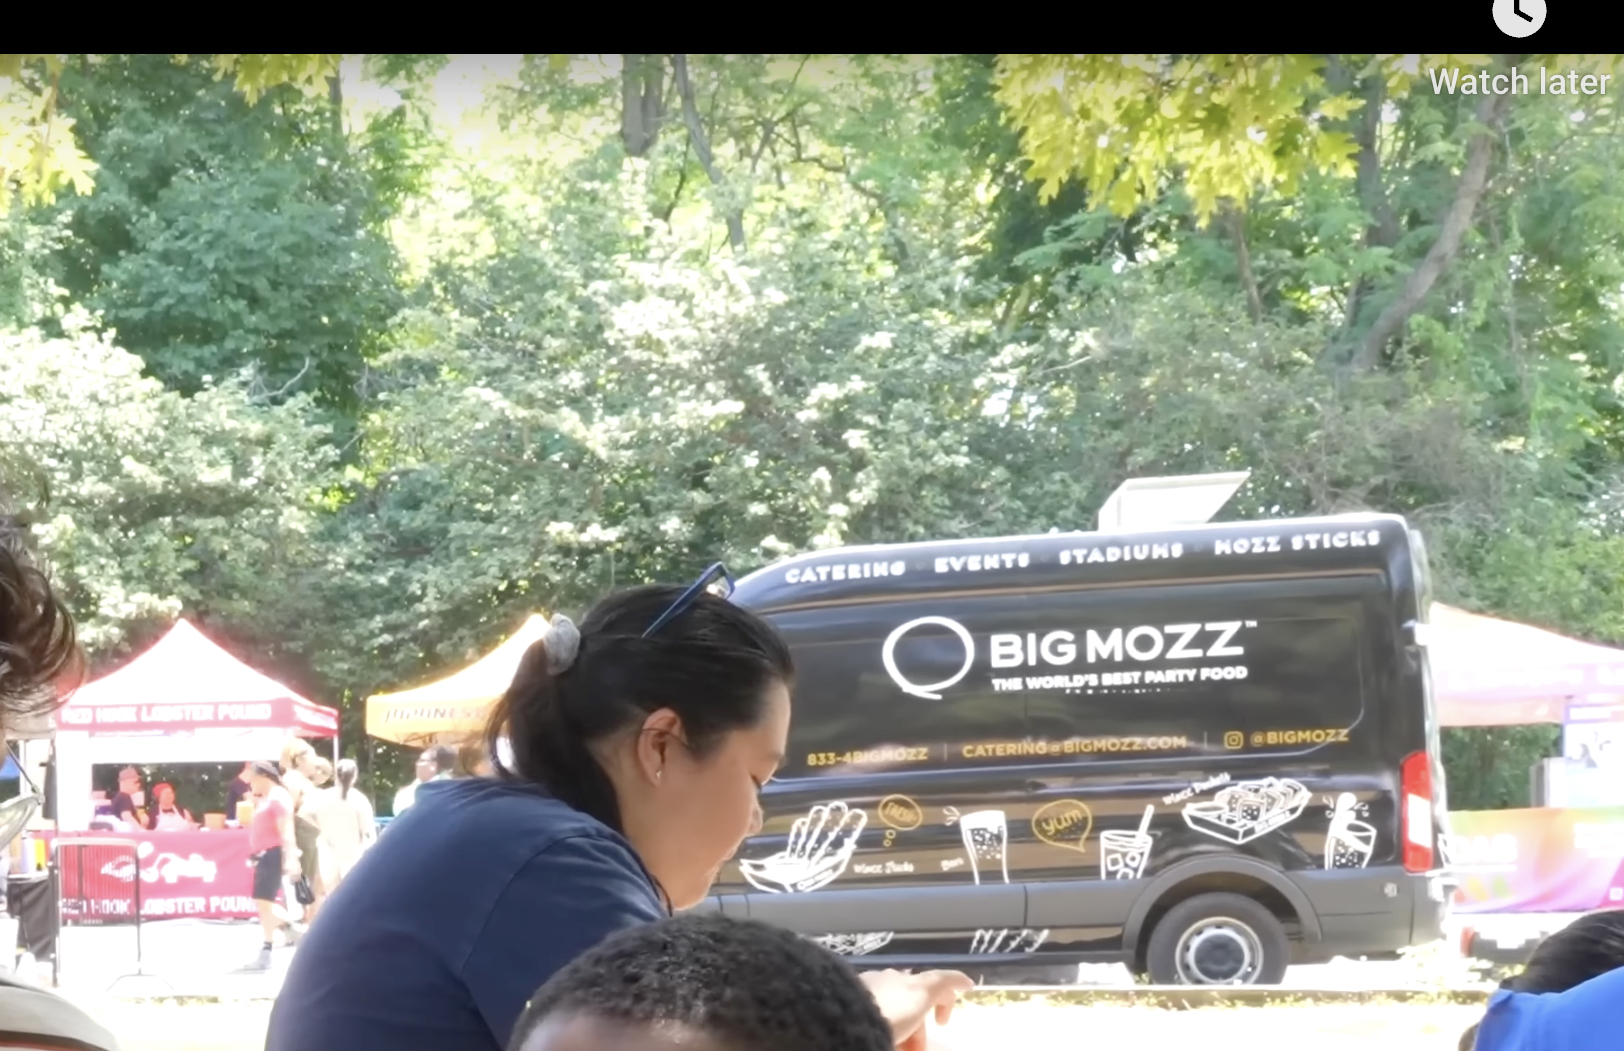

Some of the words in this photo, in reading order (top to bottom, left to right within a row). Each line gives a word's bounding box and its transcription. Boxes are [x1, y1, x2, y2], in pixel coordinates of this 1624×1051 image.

[785, 561, 906, 584] CATERING
[934, 552, 1030, 573] EVENTS
[1059, 542, 1184, 565] STADIUMS
[1214, 536, 1281, 555] MOZZ
[1291, 530, 1381, 550] STICKS
[990, 631, 1077, 668] BIG
[991, 678, 1023, 691] THE
[1025, 673, 1099, 690] WORLD'S
[1101, 671, 1142, 686] BEST
[1144, 668, 1197, 684] PARTY
[1200, 666, 1248, 681] FOOD
[140, 704, 214, 723] LOBSTER
[217, 702, 272, 721] POUND
[807, 747, 928, 767] 833-4BIGMOZZ
[962, 736, 1188, 758] CATERING@BIGMOZZ.COM
[1250, 728, 1350, 747] @BIGMOZZ
[139, 896, 207, 915] OBSTER
